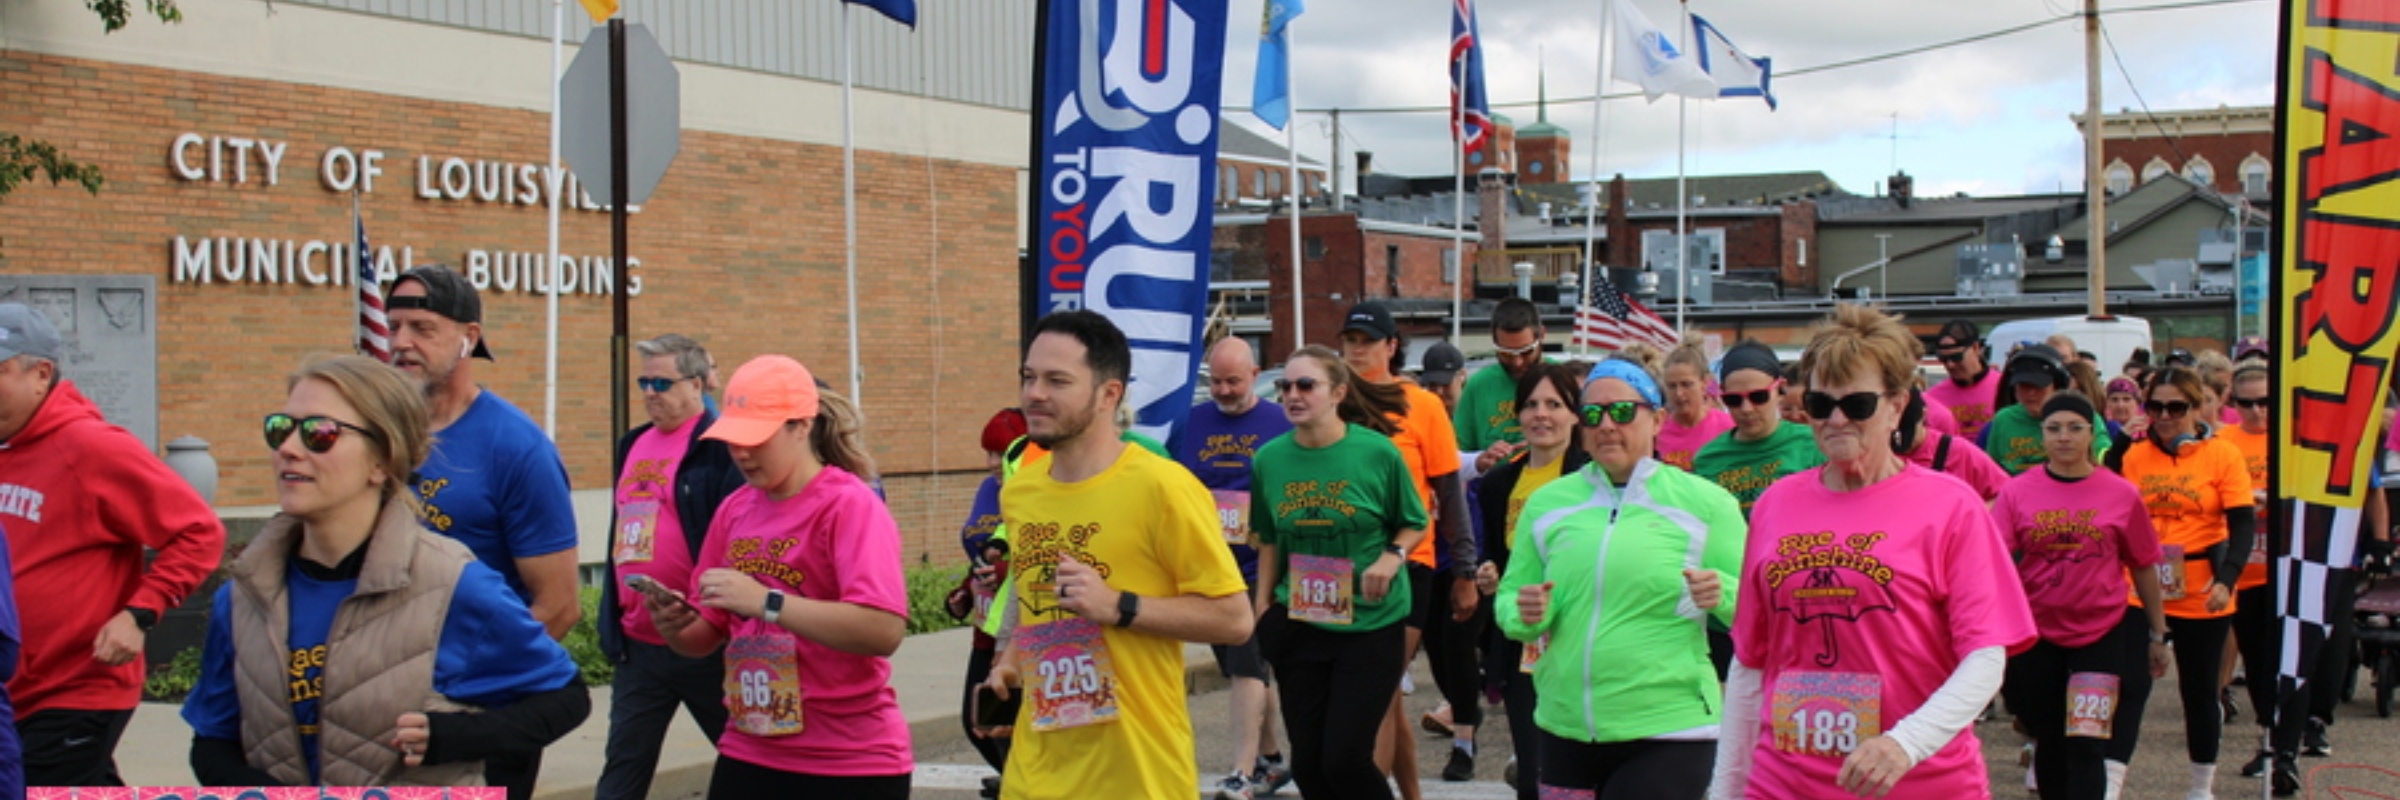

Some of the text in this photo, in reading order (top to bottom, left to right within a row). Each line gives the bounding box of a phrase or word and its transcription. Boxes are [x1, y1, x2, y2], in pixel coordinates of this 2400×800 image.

[171, 132, 642, 213] CITY OF LOUISVIL
[467, 249, 643, 296] BUILDING
[1218, 507, 1239, 529] 98
[1777, 531, 1889, 556] Rae of
[1765, 545, 1894, 590] Sunshine
[1300, 578, 1338, 605] 131
[740, 669, 772, 707] 66
[1039, 654, 1099, 699] 225
[2074, 693, 2112, 721] 228
[1791, 708, 1858, 753] 183
